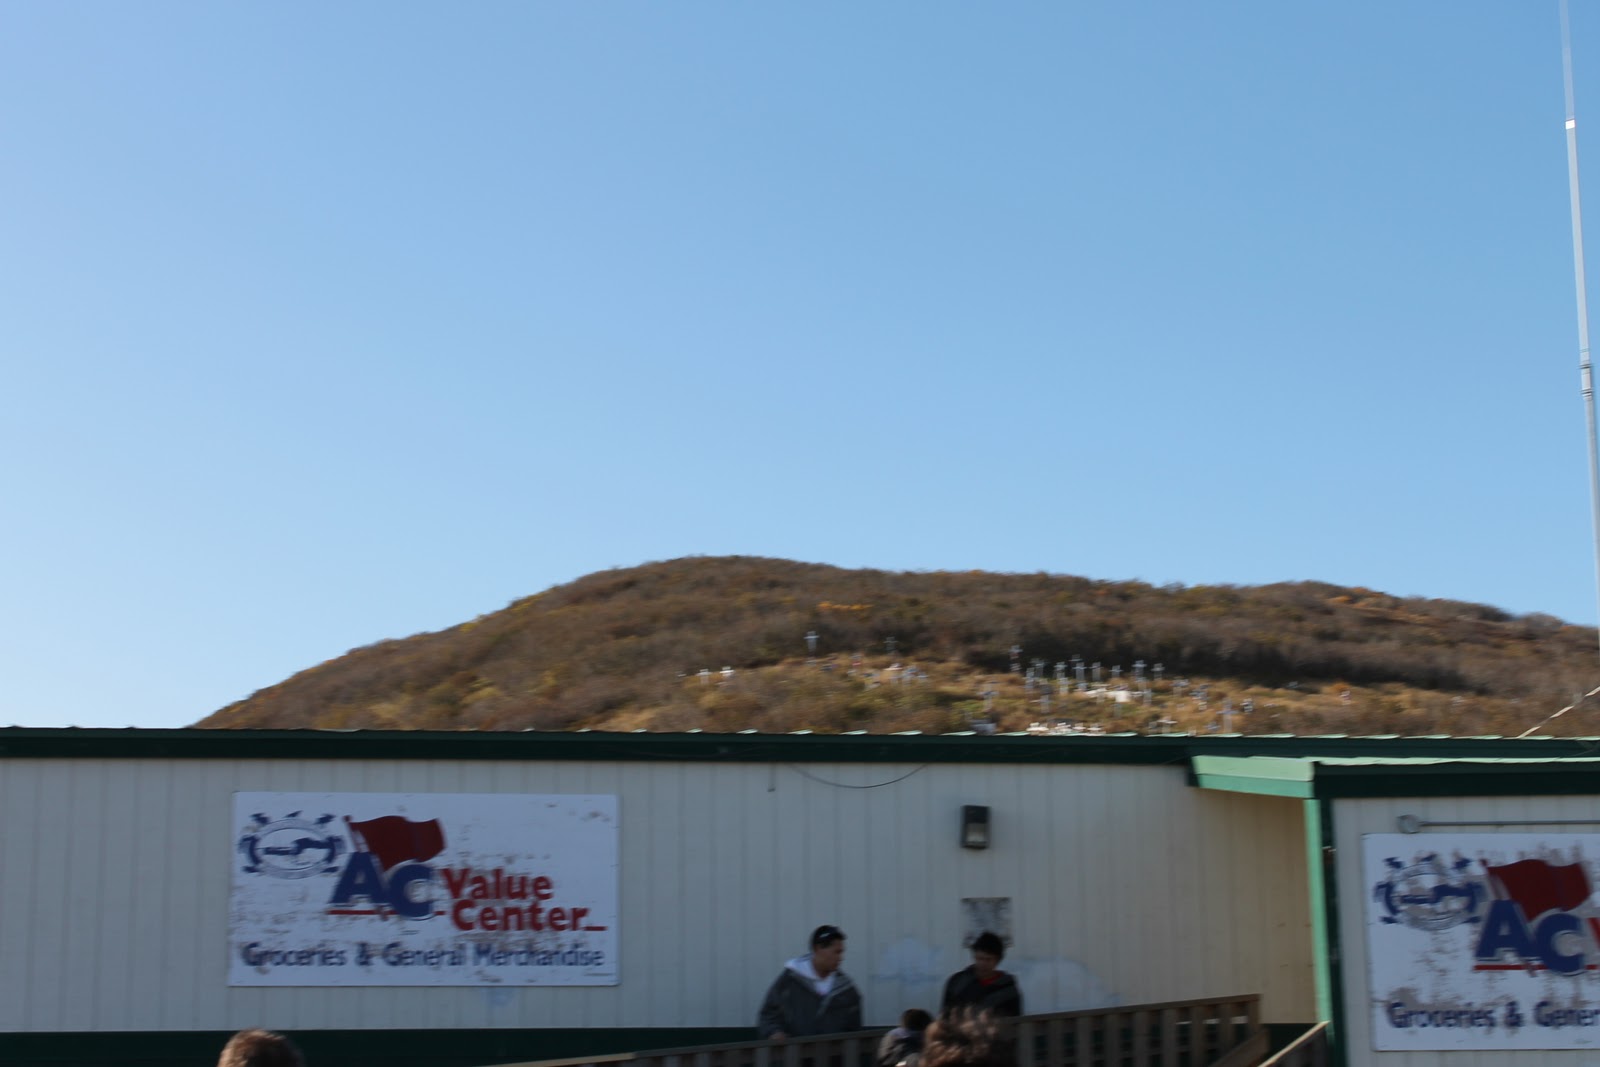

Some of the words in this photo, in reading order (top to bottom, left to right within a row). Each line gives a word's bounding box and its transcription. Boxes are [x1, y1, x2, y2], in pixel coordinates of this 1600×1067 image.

[330, 851, 435, 920] AC
[441, 868, 554, 900] Value
[452, 901, 590, 931] Center
[1475, 899, 1587, 974] AC
[242, 942, 346, 967] Groceries
[356, 942, 374, 967] &
[381, 942, 466, 967] General
[473, 942, 605, 967] Merchandise
[1387, 1001, 1496, 1028] Groceries
[1504, 1000, 1524, 1028] &
